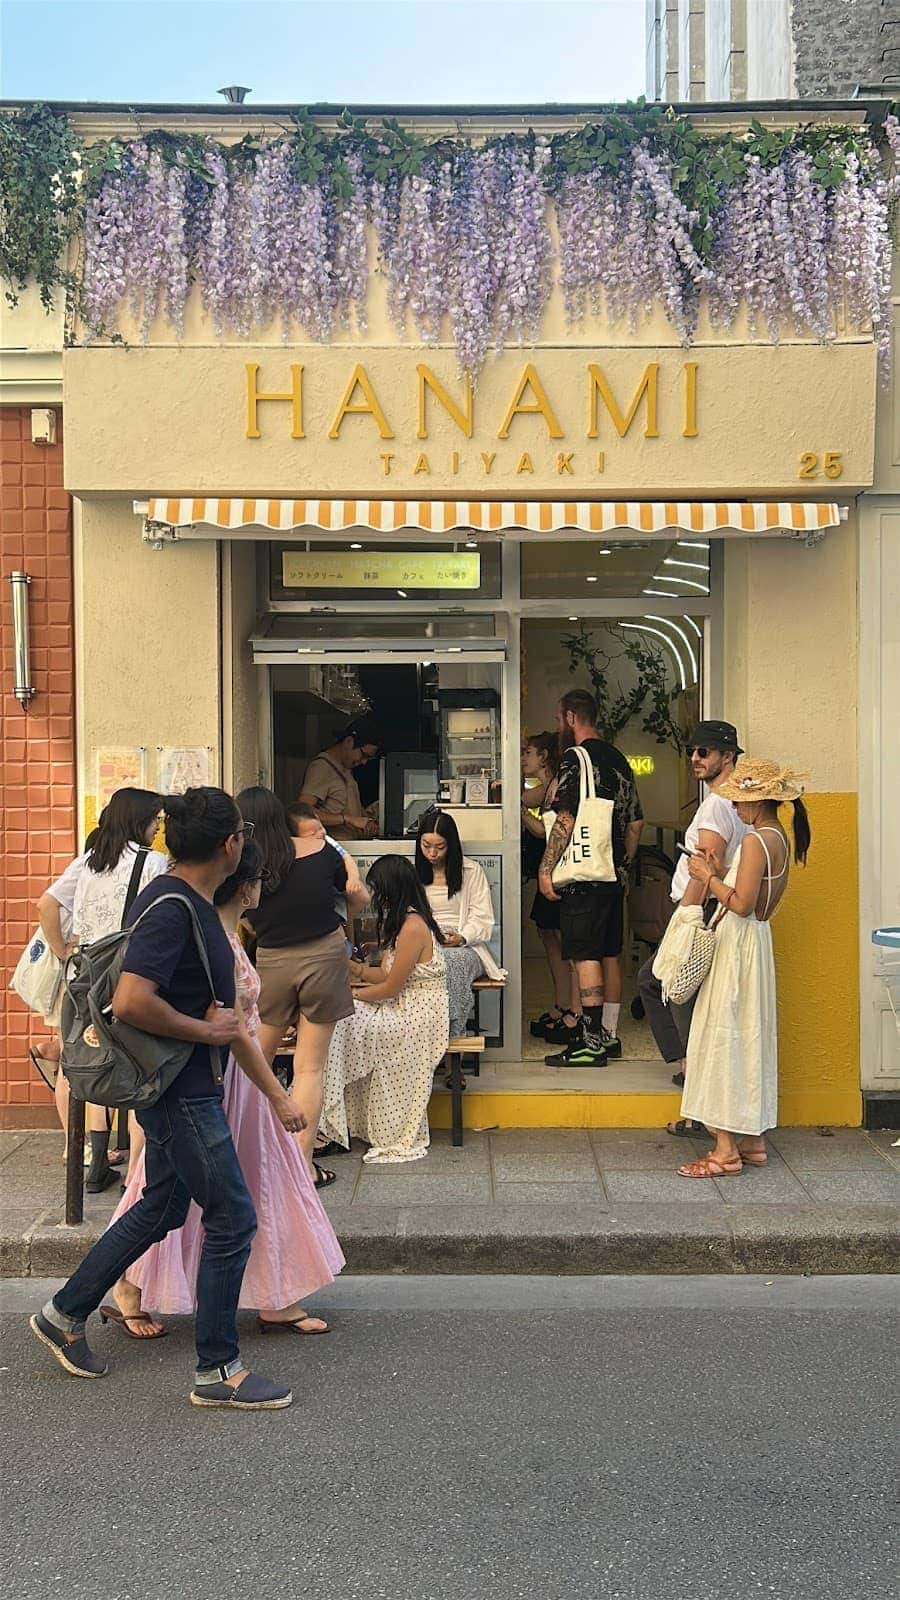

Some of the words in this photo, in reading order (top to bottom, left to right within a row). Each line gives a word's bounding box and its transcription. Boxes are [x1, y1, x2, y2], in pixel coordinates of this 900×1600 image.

[245, 363, 698, 439] HANAMI
[380, 451, 606, 476] TAIYAKI
[798, 451, 843, 479] 25
